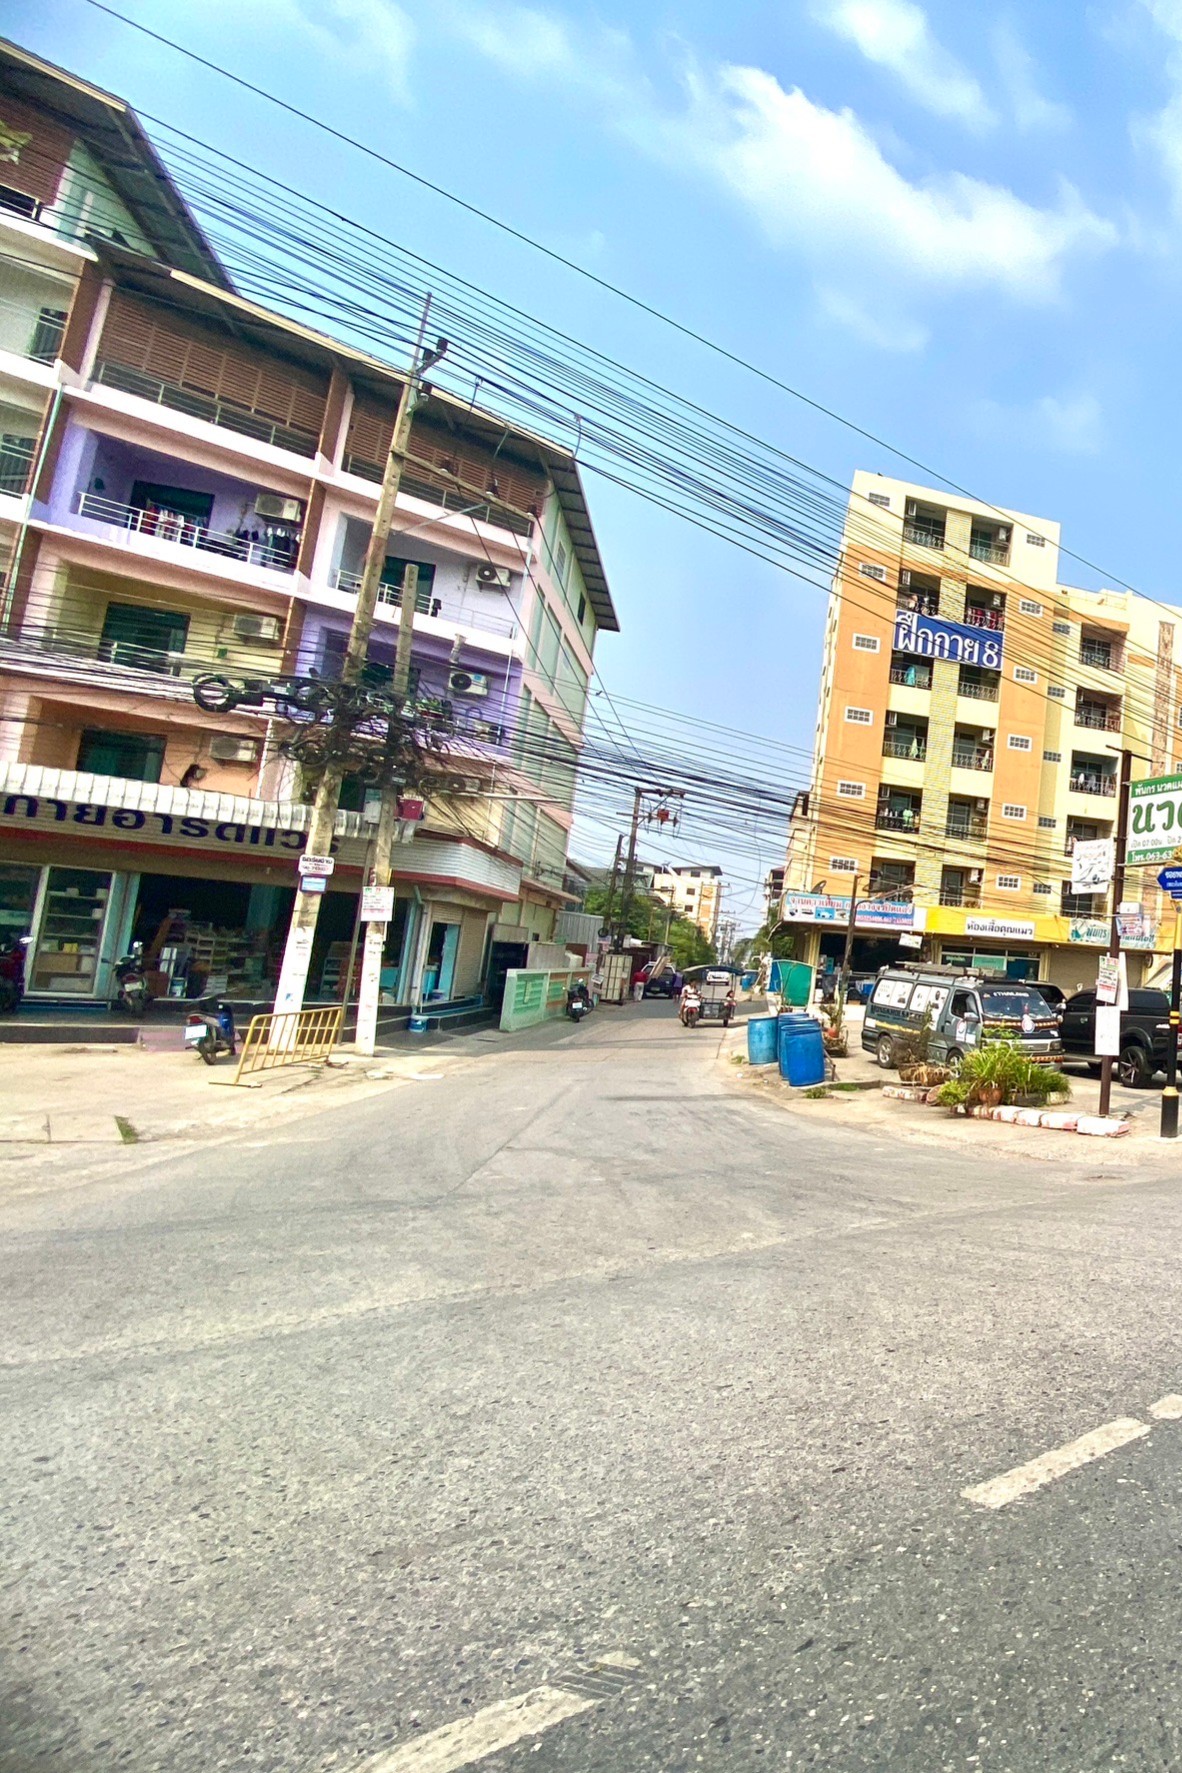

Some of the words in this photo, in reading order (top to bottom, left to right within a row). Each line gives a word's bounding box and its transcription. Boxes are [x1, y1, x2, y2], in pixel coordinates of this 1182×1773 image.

[982, 641, 999, 668] 8
[966, 919, 1034, 937] ห้องเสื้อคุณแมว
